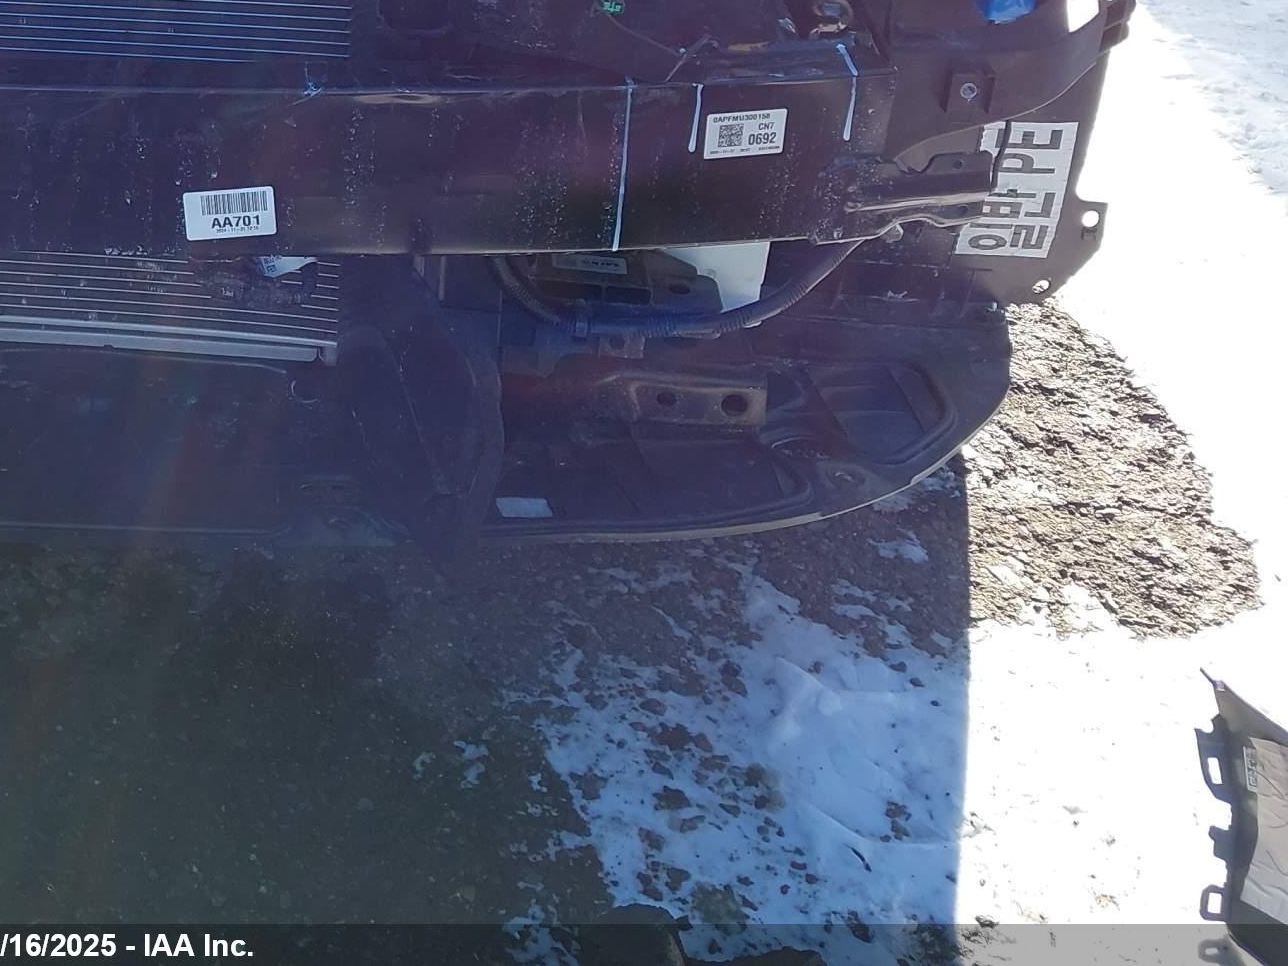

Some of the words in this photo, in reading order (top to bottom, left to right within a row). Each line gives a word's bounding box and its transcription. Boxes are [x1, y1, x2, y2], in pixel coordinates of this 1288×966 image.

[758, 122, 775, 131] CN7
[748, 132, 777, 146] 0692
[994, 128, 1064, 174] PE
[211, 215, 260, 229] AA701
